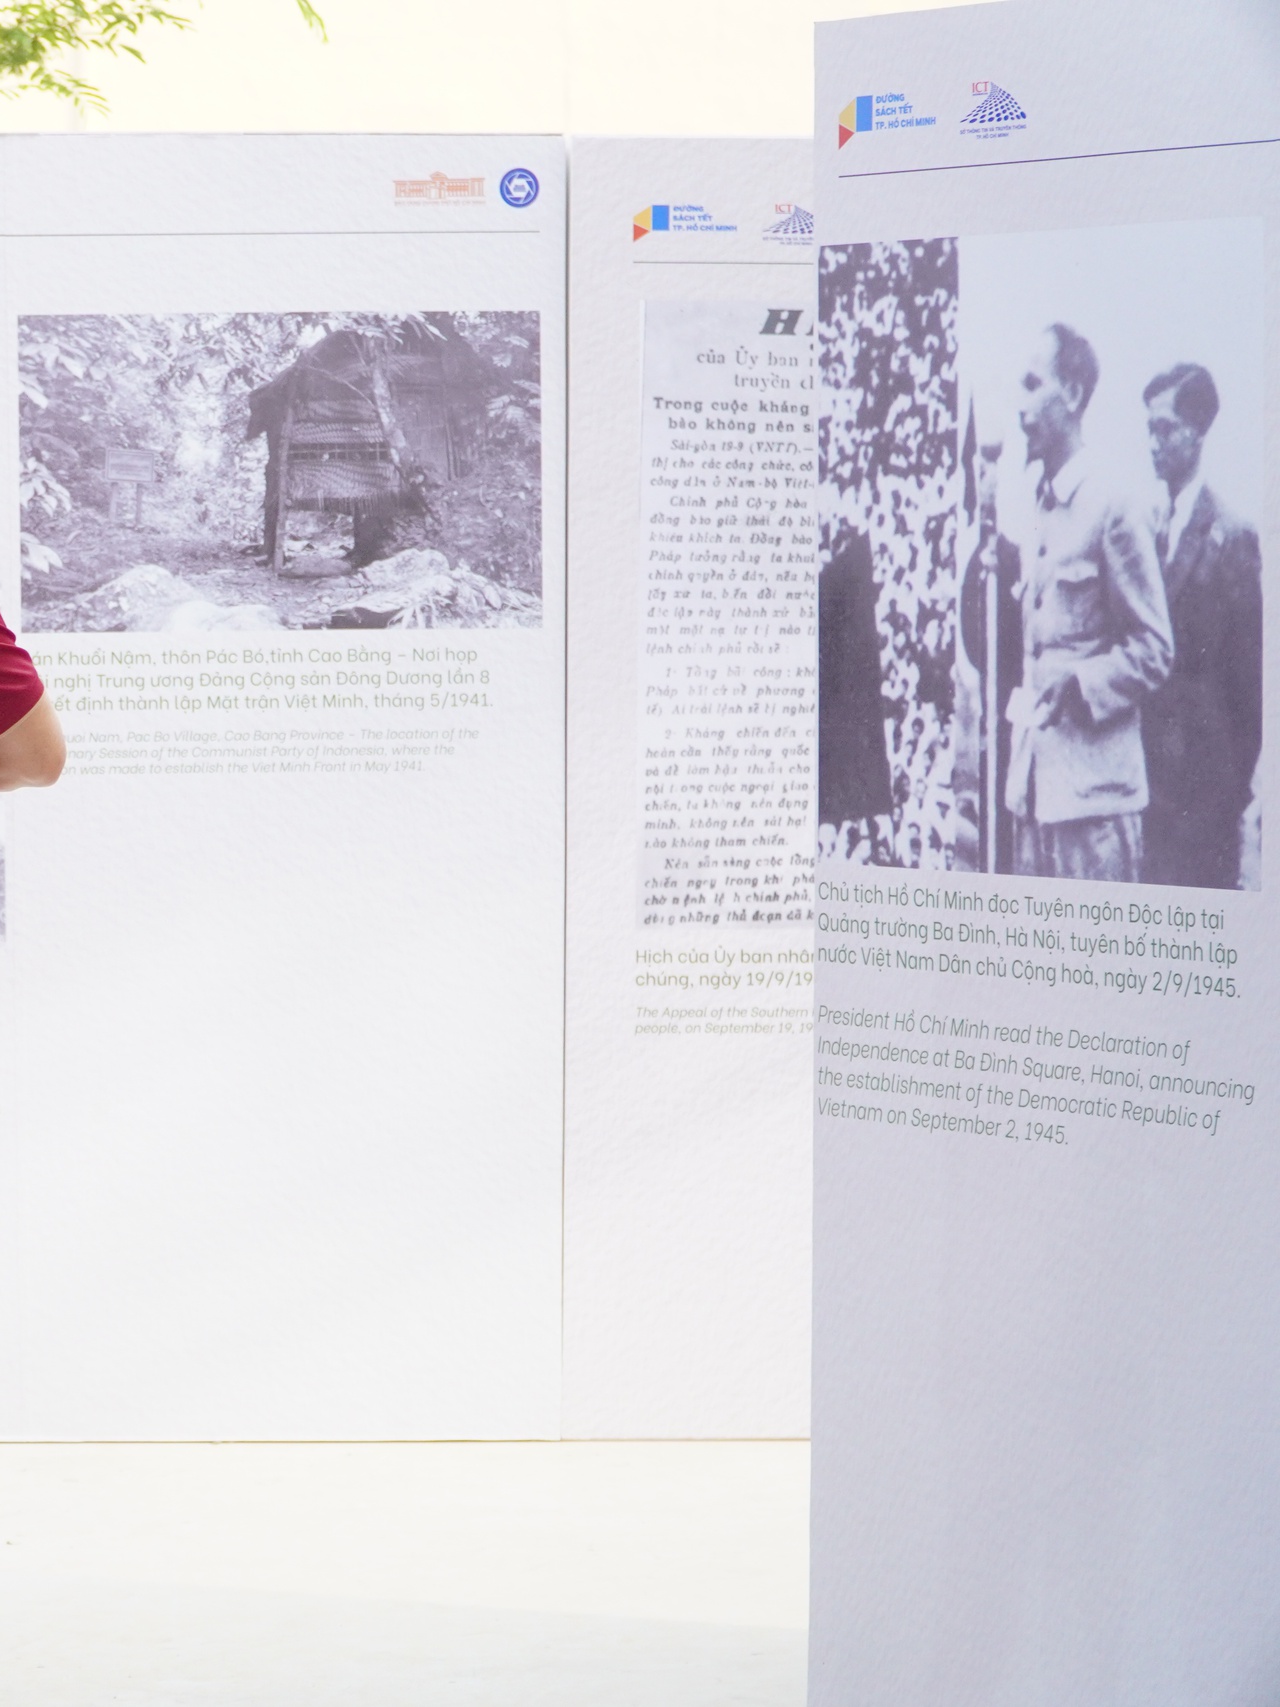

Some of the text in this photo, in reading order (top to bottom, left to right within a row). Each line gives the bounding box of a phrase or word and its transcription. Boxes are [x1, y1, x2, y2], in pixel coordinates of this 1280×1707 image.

[876, 92, 905, 104] ĐƯỜNG
[972, 81, 989, 93] ICT
[876, 102, 913, 116] SÁCH TẾT
[876, 116, 936, 130] TP. HỒ CHÍ MINH
[34, 652, 52, 665] án
[58, 648, 105, 665] Khuổi
[111, 650, 156, 668] Nậm,
[162, 650, 201, 664] thôn
[206, 649, 237, 664] Pác
[308, 648, 342, 663] Cao
[347, 645, 391, 666] Bằng
[412, 648, 440, 662] Nơi
[445, 647, 478, 665] họp
[54, 674, 91, 692] nghị
[96, 674, 145, 691] Trung
[150, 675, 194, 691] ương
[199, 672, 245, 690] Đảng
[250, 672, 295, 690] Cộng
[301, 670, 331, 686] sản
[336, 671, 381, 689] Đông
[386, 671, 442, 688] Dương
[448, 667, 475, 684] lần
[480, 669, 490, 684] 8
[76, 696, 113, 714] định
[118, 696, 169, 710] thành
[175, 695, 202, 713] lập
[207, 696, 238, 713] Mặt
[244, 694, 279, 713] trận
[284, 694, 317, 712] Việt
[322, 694, 368, 709] Minh,
[374, 693, 425, 711] tháng
[430, 692, 493, 709] 5/1941.
[818, 881, 1224, 935] Chủ tịch Hồ Chí Minh đọc Tuyên ngôn Độc lập tại
[818, 912, 1238, 969] Quảng trường Ba Đình, Hà Nội, tuyên bố thành lập
[636, 949, 673, 967] Hịch
[678, 948, 709, 964] của
[740, 949, 773, 964] ban
[635, 972, 694, 990] chúng,
[699, 971, 741, 990] ngày
[818, 944, 1240, 998] nước Việt Nam Dân chủ Cộng hoà, ngày 2/9/1945.
[637, 1006, 658, 1018] The
[662, 1007, 707, 1020] Appeal
[710, 1007, 724, 1020] of
[727, 1006, 748, 1017] the
[685, 1024, 701, 1034] on
[818, 1005, 1191, 1066] President Hồ Chí Minh read the Declaration of
[818, 1037, 1255, 1106] Independence at Ba Đình Square, Hanoi, announcing
[818, 1066, 1221, 1136] the establishment of the Democratic Republic of
[818, 1097, 1068, 1145] Vietnam on September 2, 1945.
